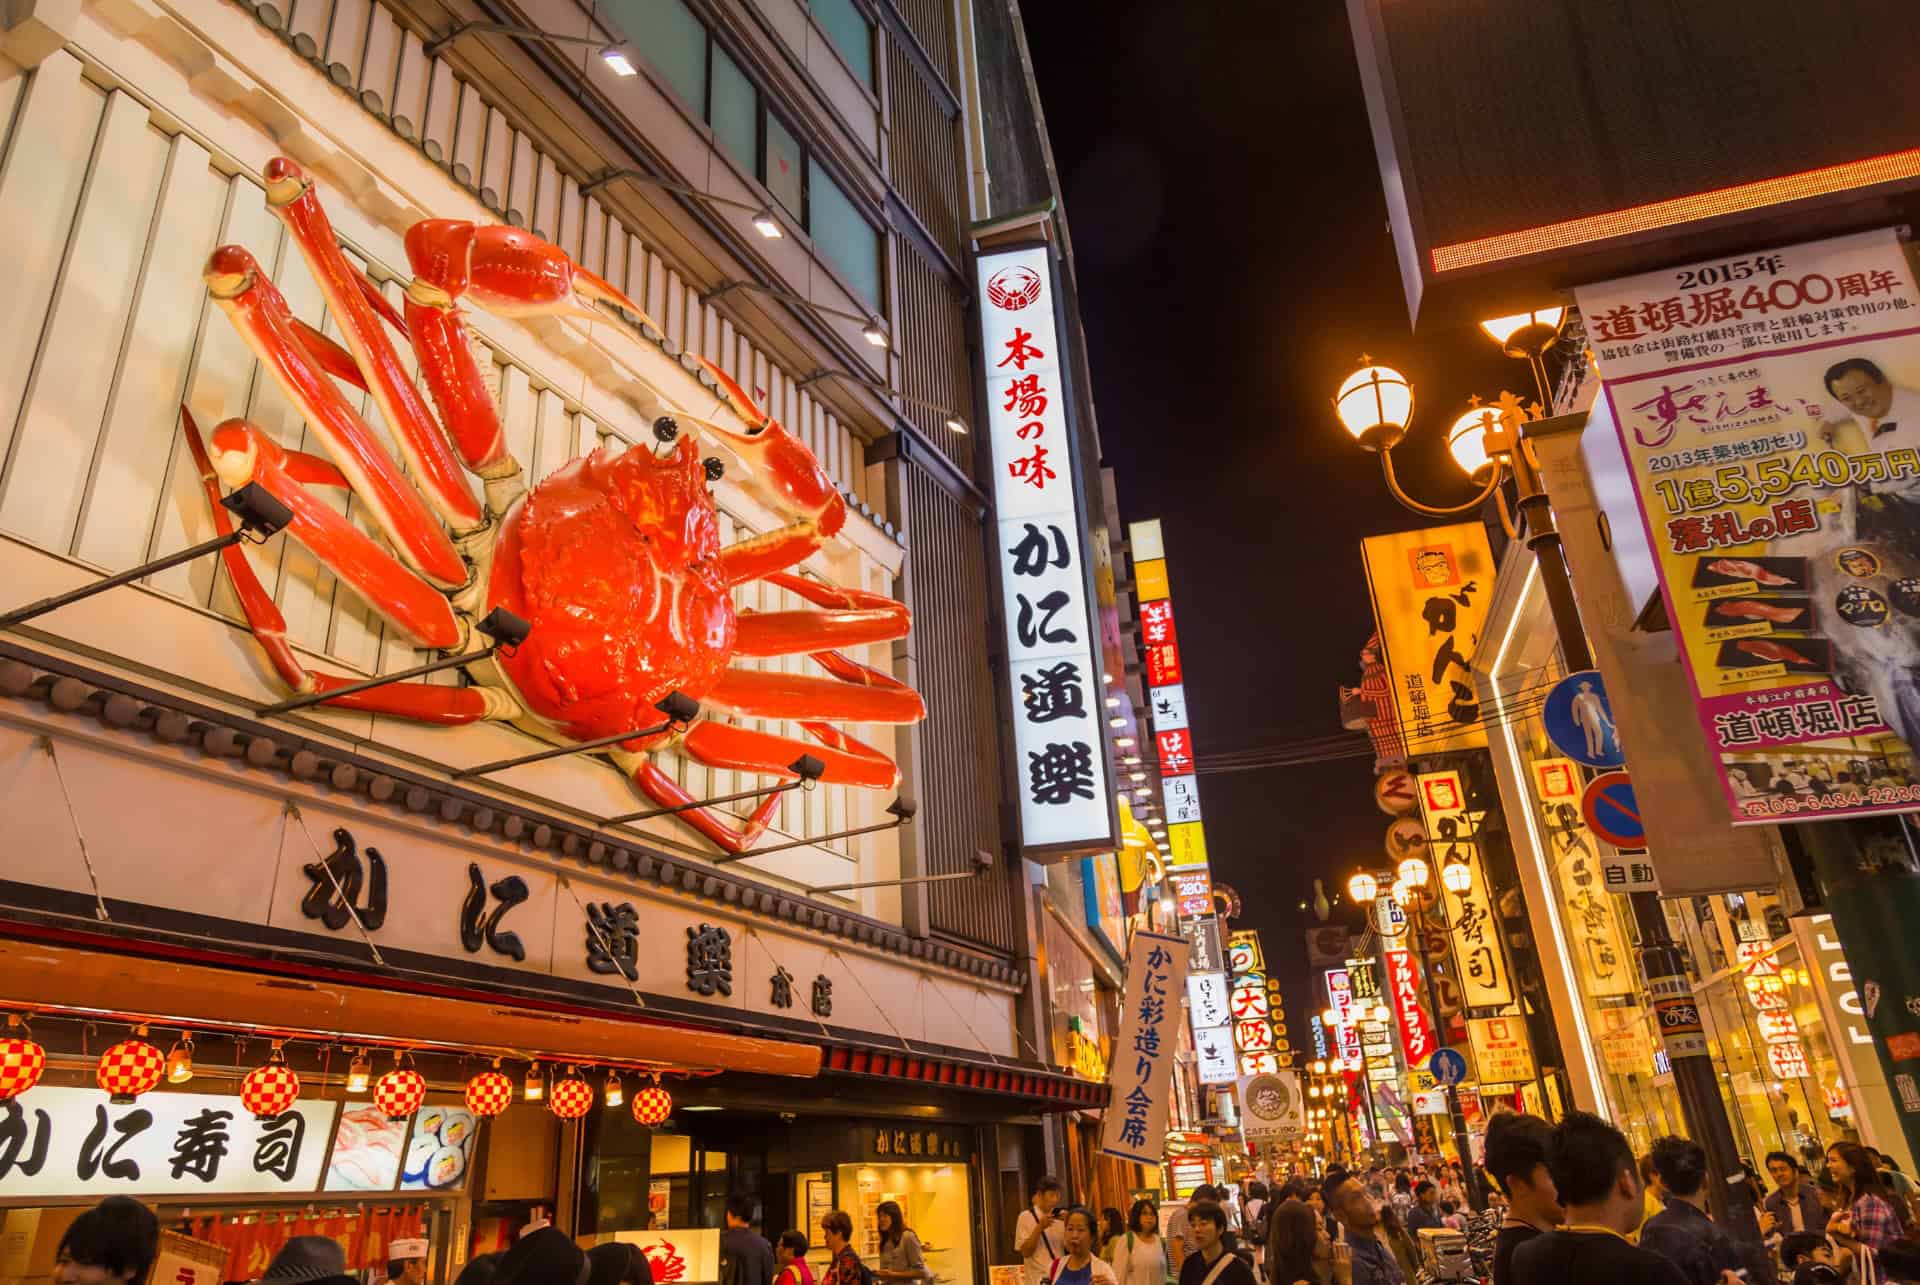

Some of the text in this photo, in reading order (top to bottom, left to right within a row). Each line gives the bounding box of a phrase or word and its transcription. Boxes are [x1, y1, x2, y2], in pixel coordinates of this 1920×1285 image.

[1591, 270, 1904, 344] 道頓堀400周年
[1677, 255, 1786, 290] 2015年
[997, 327, 1057, 489] 本場の味
[1649, 432, 1808, 471] 2013年築地初セリ
[1655, 448, 1920, 515] 1億5,540万円
[1668, 498, 1818, 552] 落札の店
[1008, 523, 1095, 805] かに道樂
[1714, 695, 1884, 748] 道頓堀店
[1391, 953, 1427, 1057] ツルハドラッグ
[1119, 945, 1173, 1149] かに彩造り会席
